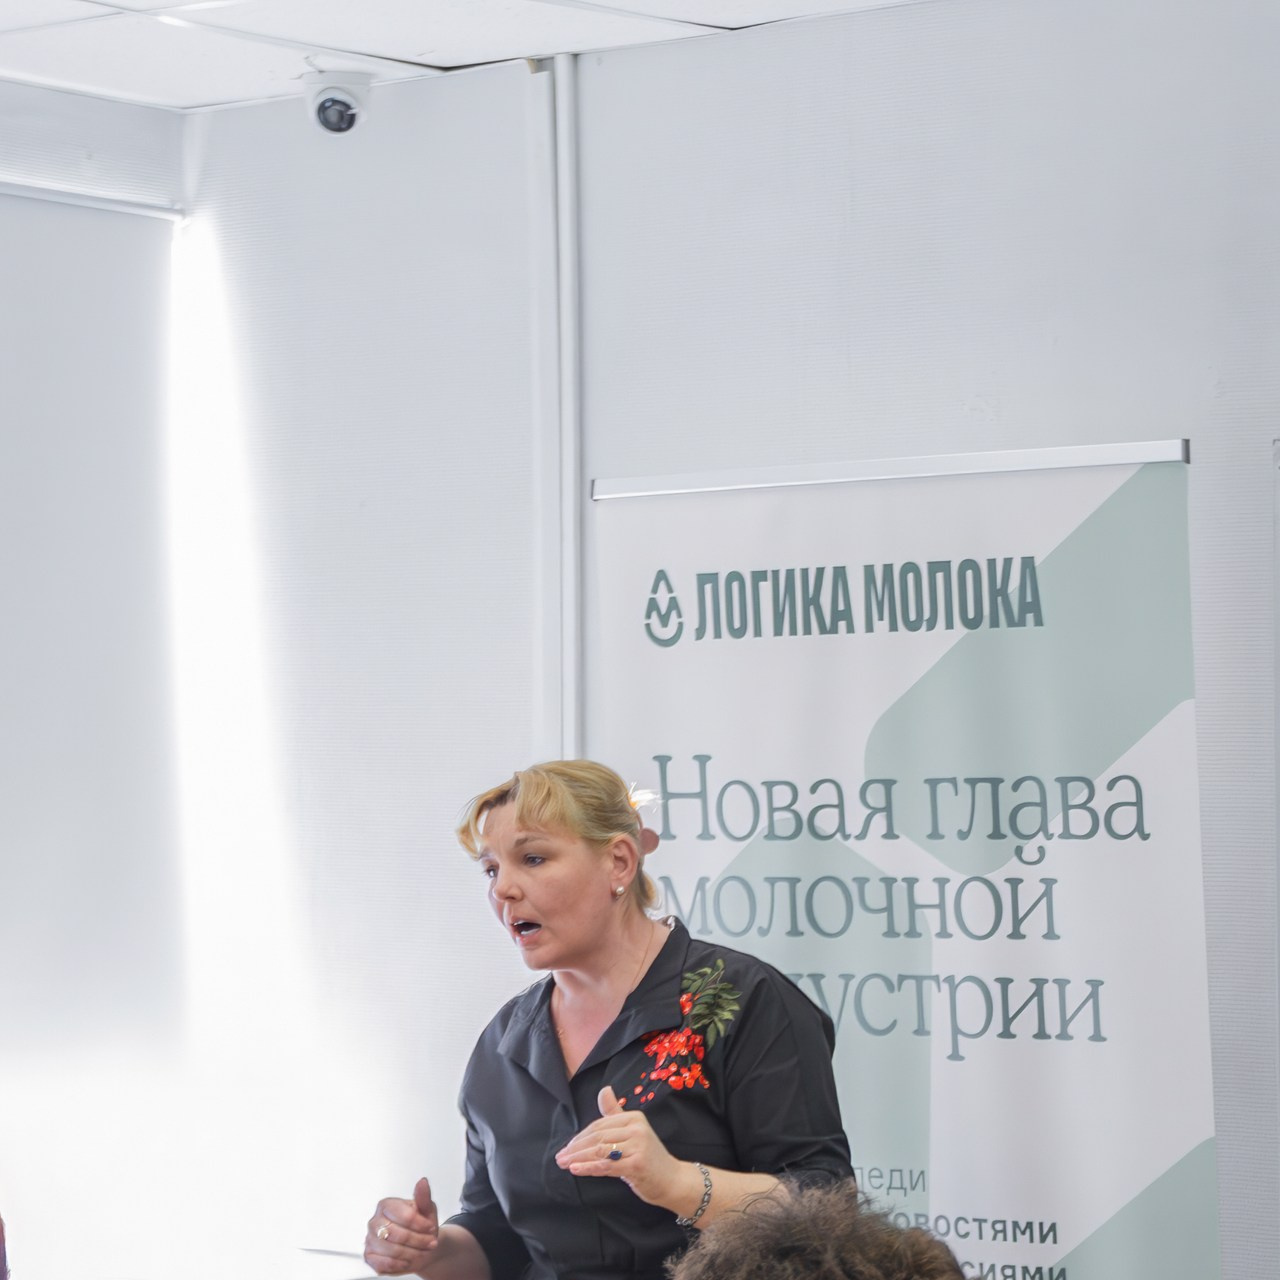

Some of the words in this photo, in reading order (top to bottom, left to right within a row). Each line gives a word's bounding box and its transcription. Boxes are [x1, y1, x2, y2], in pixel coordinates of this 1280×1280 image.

[694, 565, 856, 641] ЛОГИКА
[863, 556, 1045, 634] МОЛОКА
[651, 754, 901, 841] Новая
[923, 772, 1151, 842] глава
[657, 844, 1061, 942] молочной
[786, 971, 1108, 1062] устрии
[855, 1167, 927, 1197] леди
[892, 1212, 1058, 1245] овостями
